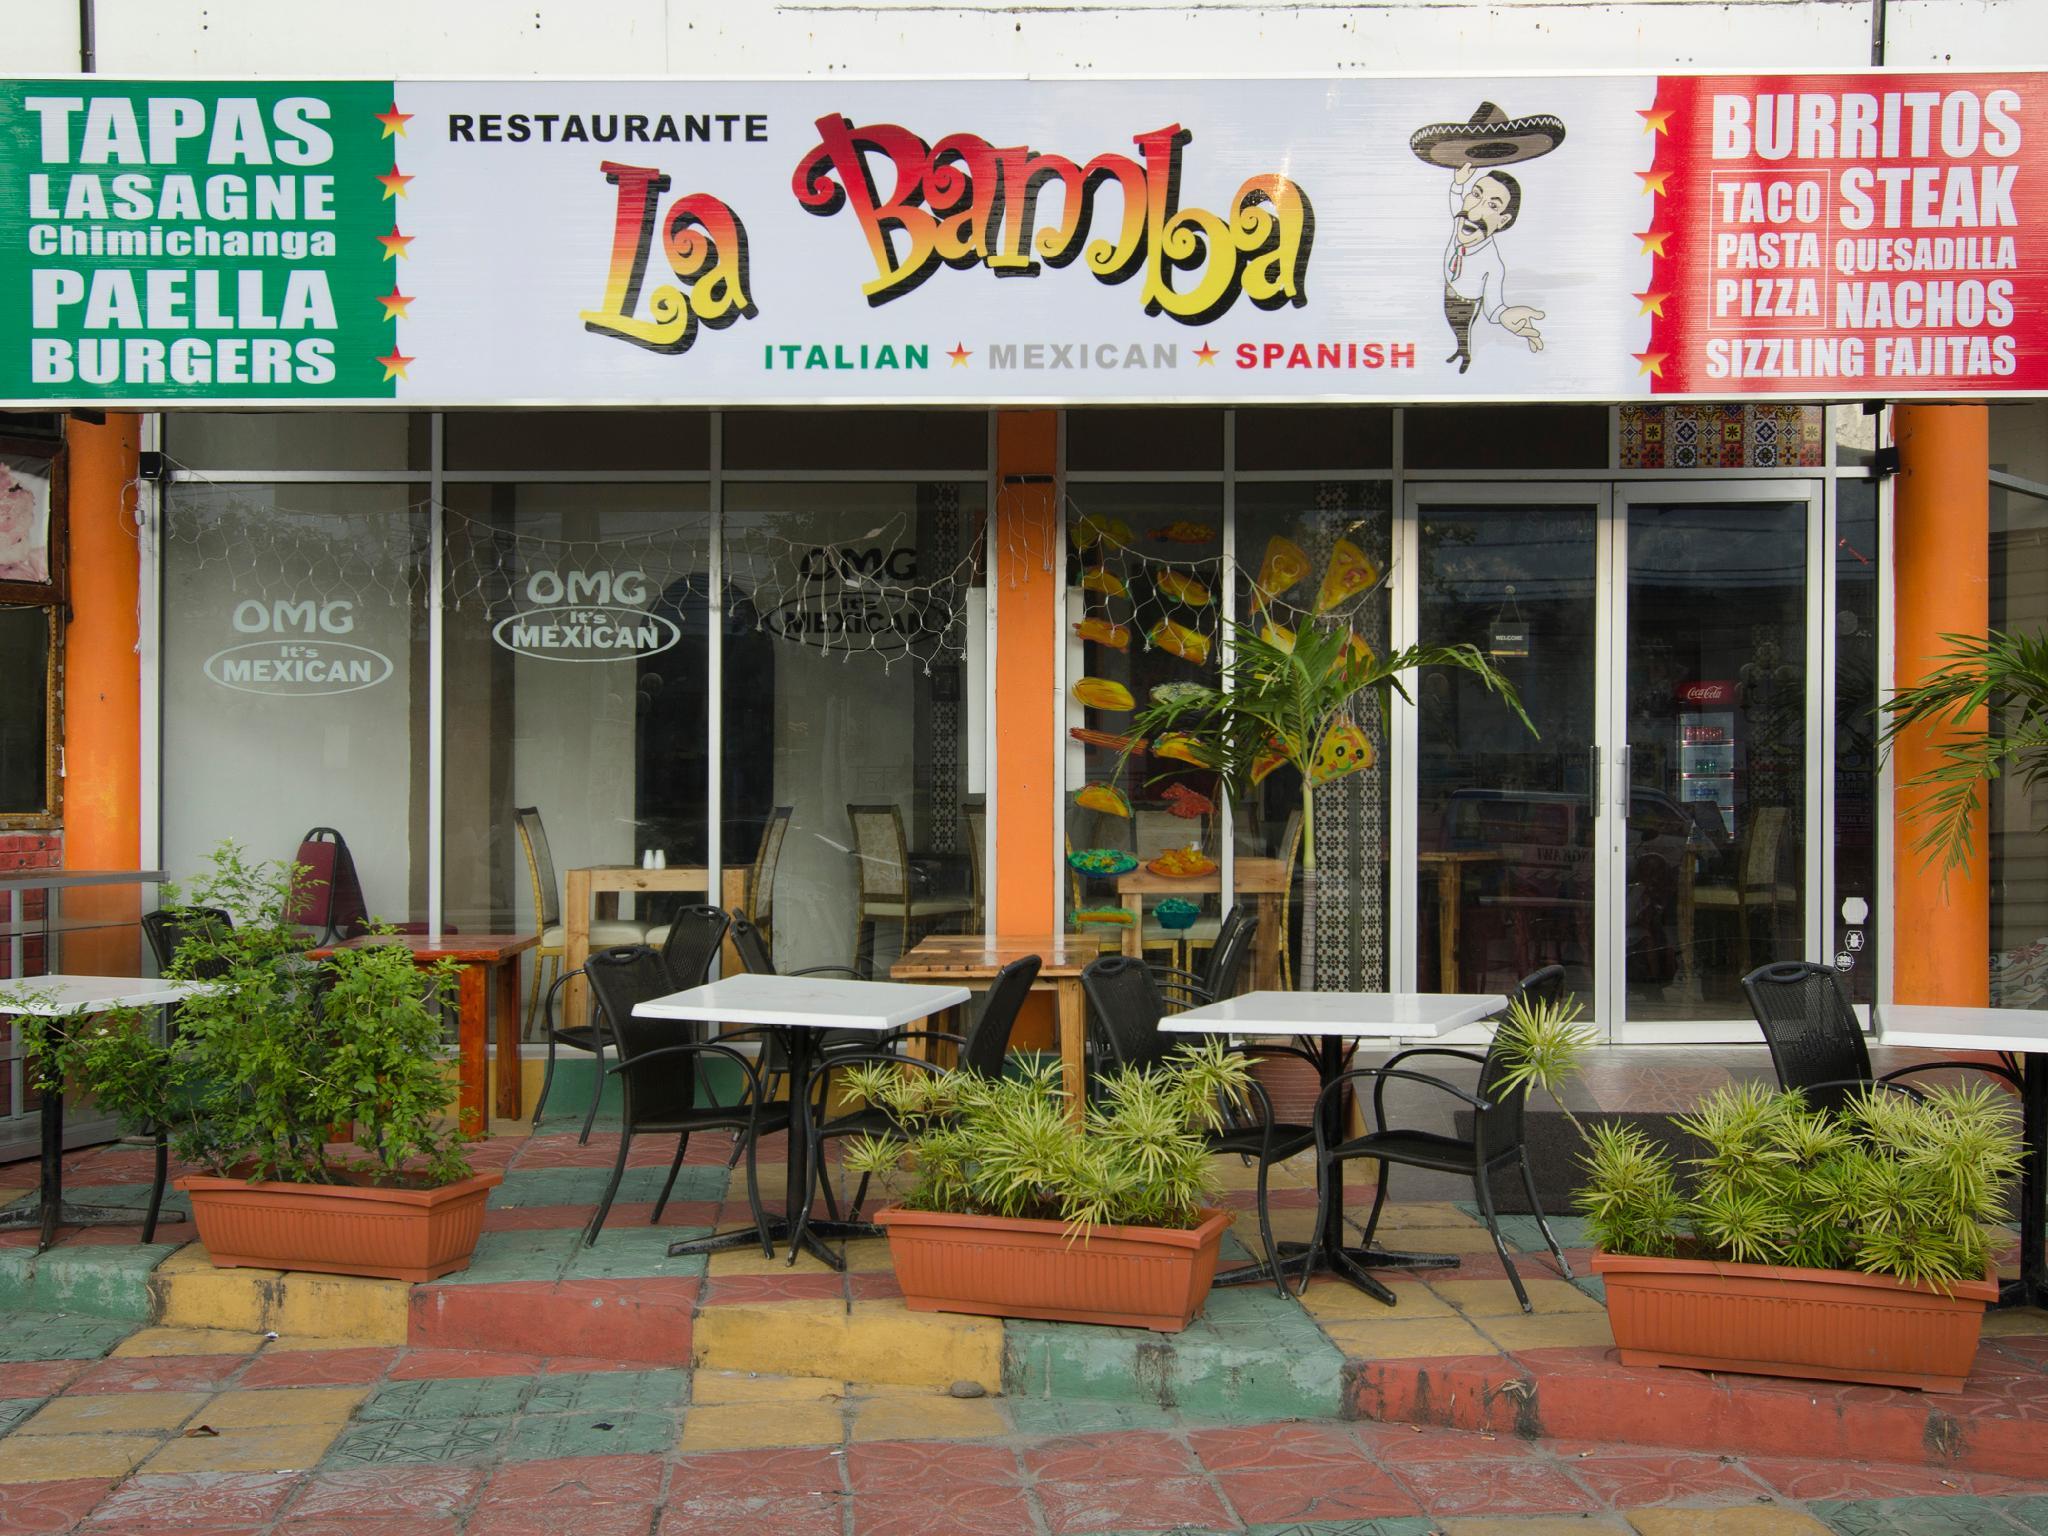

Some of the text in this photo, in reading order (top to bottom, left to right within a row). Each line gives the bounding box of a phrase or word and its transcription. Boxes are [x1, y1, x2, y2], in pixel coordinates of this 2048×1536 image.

[25, 97, 334, 166] TAPAS
[449, 115, 768, 142] RESTAURANTE
[1711, 90, 2022, 160] BURRITOS
[29, 174, 336, 221] LASAGNE
[1717, 181, 1821, 224] TACO
[1839, 166, 2020, 230] STEAK
[28, 224, 336, 259] Chimichanga
[579, 112, 1316, 355] La Bamba
[1716, 232, 1820, 269] PASTA
[1835, 237, 2017, 276] QUESADILLA
[32, 269, 338, 329] PAELLA
[1716, 278, 1820, 317] PIZZA
[1835, 279, 2014, 329] NACHOS
[31, 338, 336, 384] BURGERS
[764, 343, 1415, 370] ITALIAN MEXICAN SPANISH
[1706, 335, 2017, 379] SIZZLING FAJITAS
[527, 570, 647, 605] OMG
[233, 600, 354, 634] OMG
[512, 625, 659, 648] MEXICAN
[570, 611, 607, 624] It's
[223, 660, 371, 682] MEXICAN
[281, 646, 319, 658] It's
